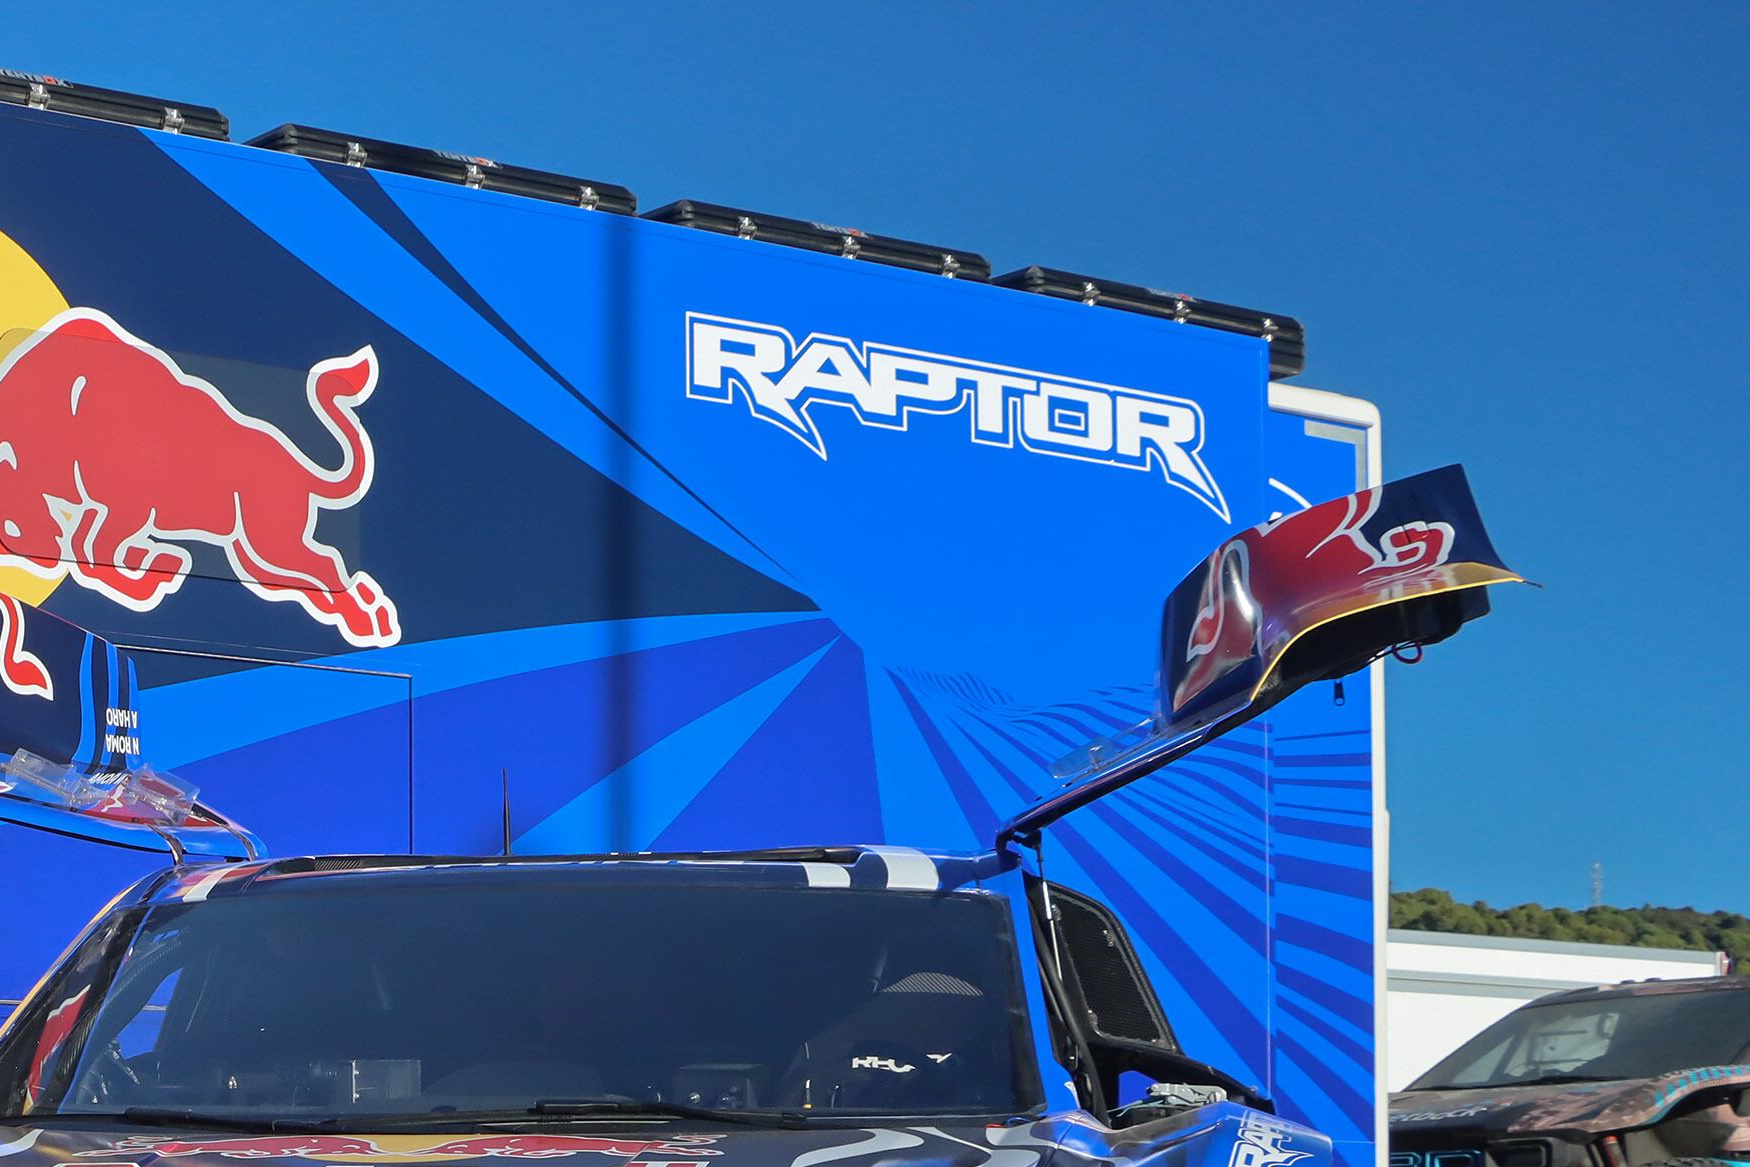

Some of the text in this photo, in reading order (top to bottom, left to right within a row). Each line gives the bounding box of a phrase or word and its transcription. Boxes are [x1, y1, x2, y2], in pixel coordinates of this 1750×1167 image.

[685, 311, 1231, 525] RAPTOR
[105, 707, 138, 729] A HARO
[105, 734, 140, 755] N ROMA
